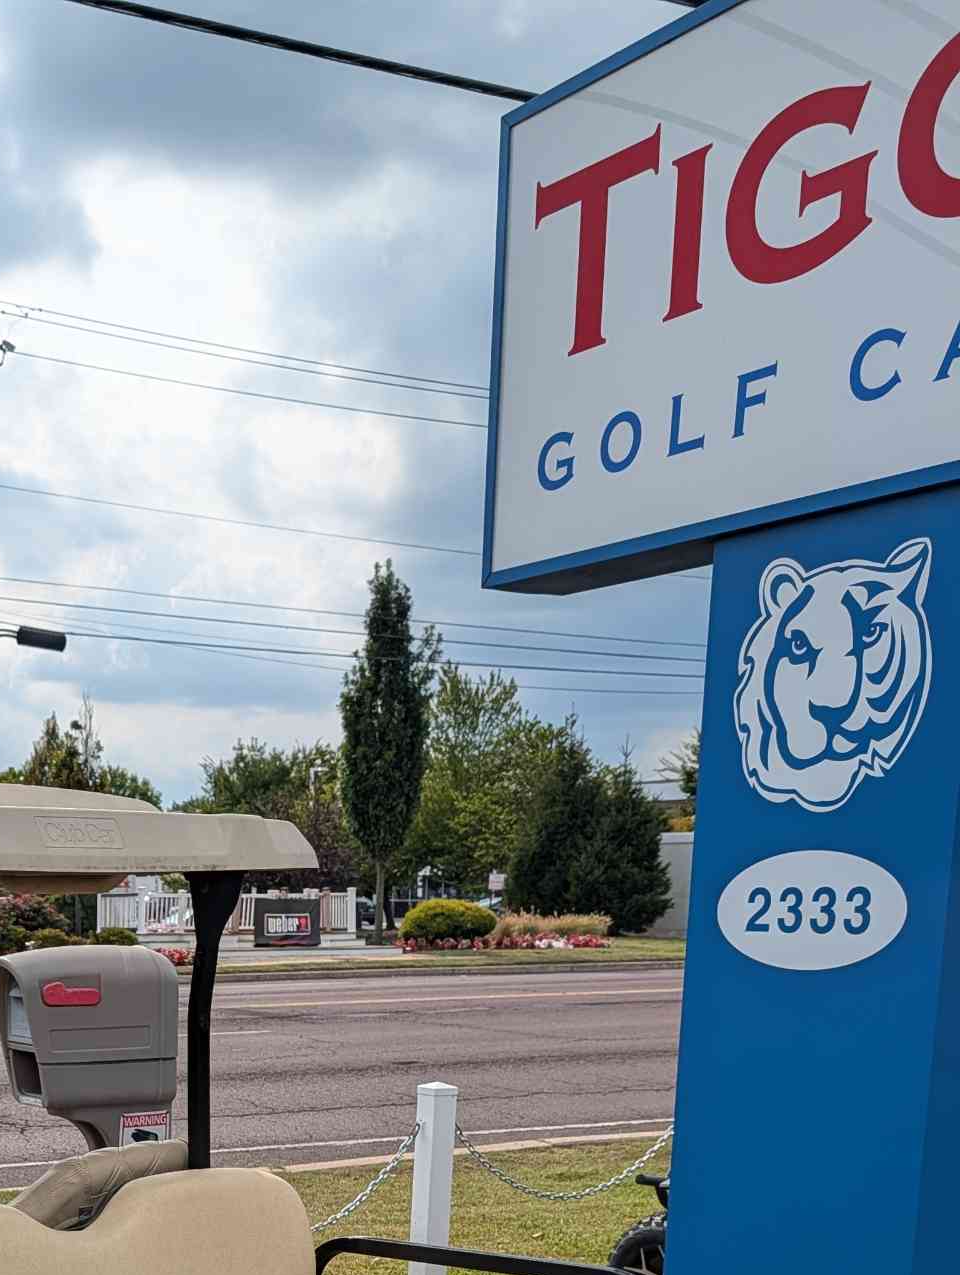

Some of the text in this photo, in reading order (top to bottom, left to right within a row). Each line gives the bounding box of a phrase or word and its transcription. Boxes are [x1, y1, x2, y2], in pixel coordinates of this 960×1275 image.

[537, 360, 778, 491] GOLF
[745, 886, 872, 935] 2333
[124, 1114, 167, 1126] WARNING
